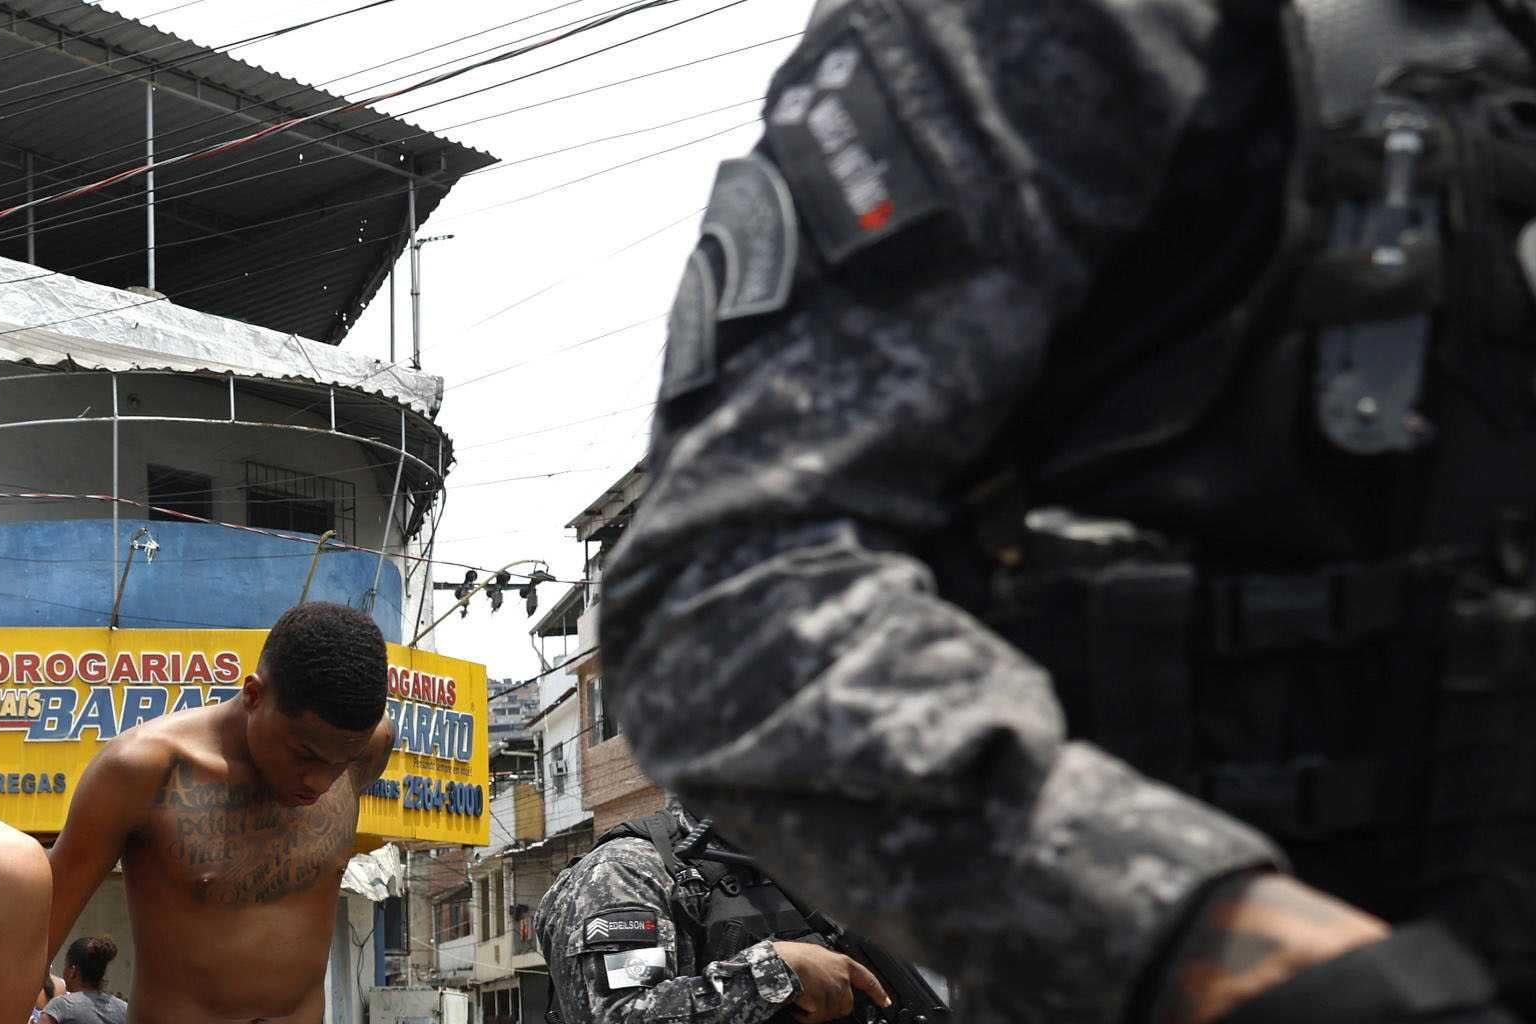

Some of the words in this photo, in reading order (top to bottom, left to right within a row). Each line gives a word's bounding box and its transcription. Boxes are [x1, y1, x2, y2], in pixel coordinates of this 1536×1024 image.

[387, 667, 456, 707] OGARIAS
[25, 687, 241, 741] BAR
[403, 774, 483, 817] 2564-3000
